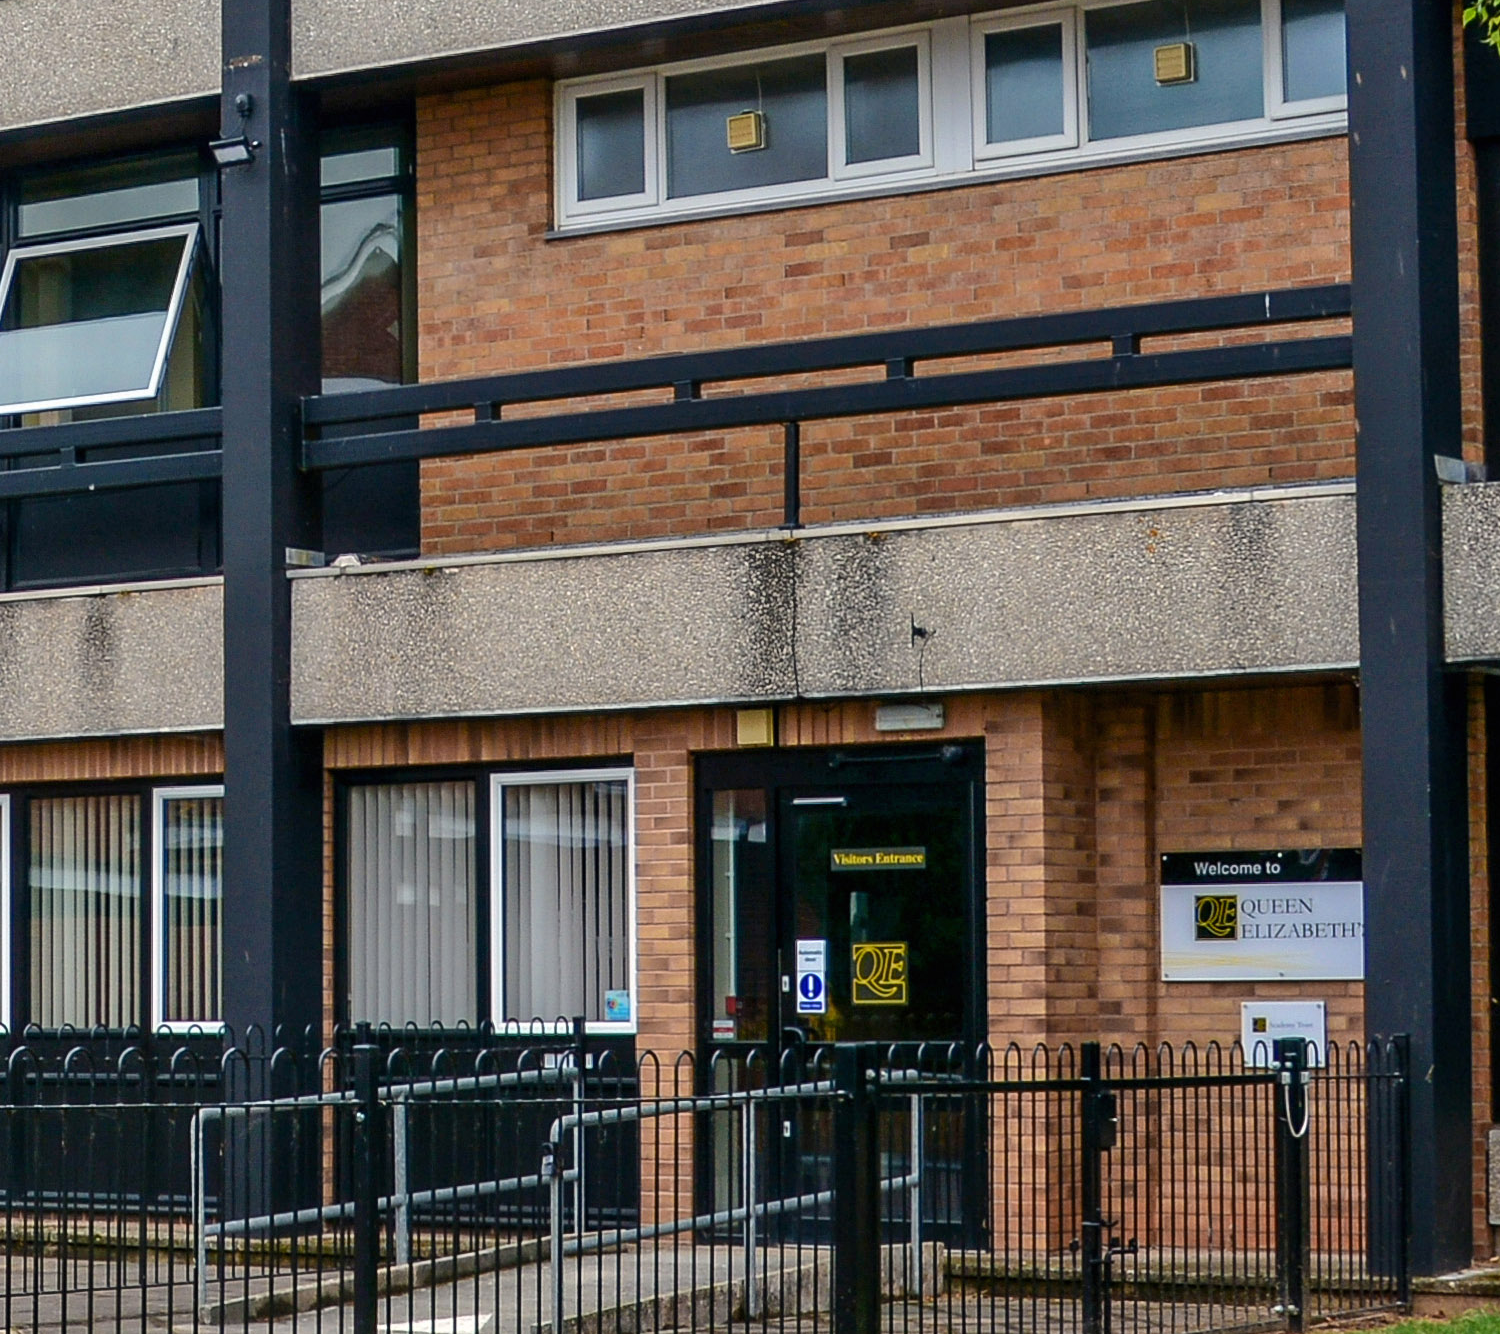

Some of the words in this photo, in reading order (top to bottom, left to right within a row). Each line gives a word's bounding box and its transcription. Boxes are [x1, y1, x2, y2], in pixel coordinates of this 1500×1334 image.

[833, 853, 874, 865] Visitors
[876, 852, 924, 864] Entrance
[1194, 862, 1262, 876] Welcome
[1266, 861, 1281, 874] to
[1197, 897, 1237, 937] QE
[1240, 898, 1313, 919] QUEEN
[854, 946, 906, 998] QE
